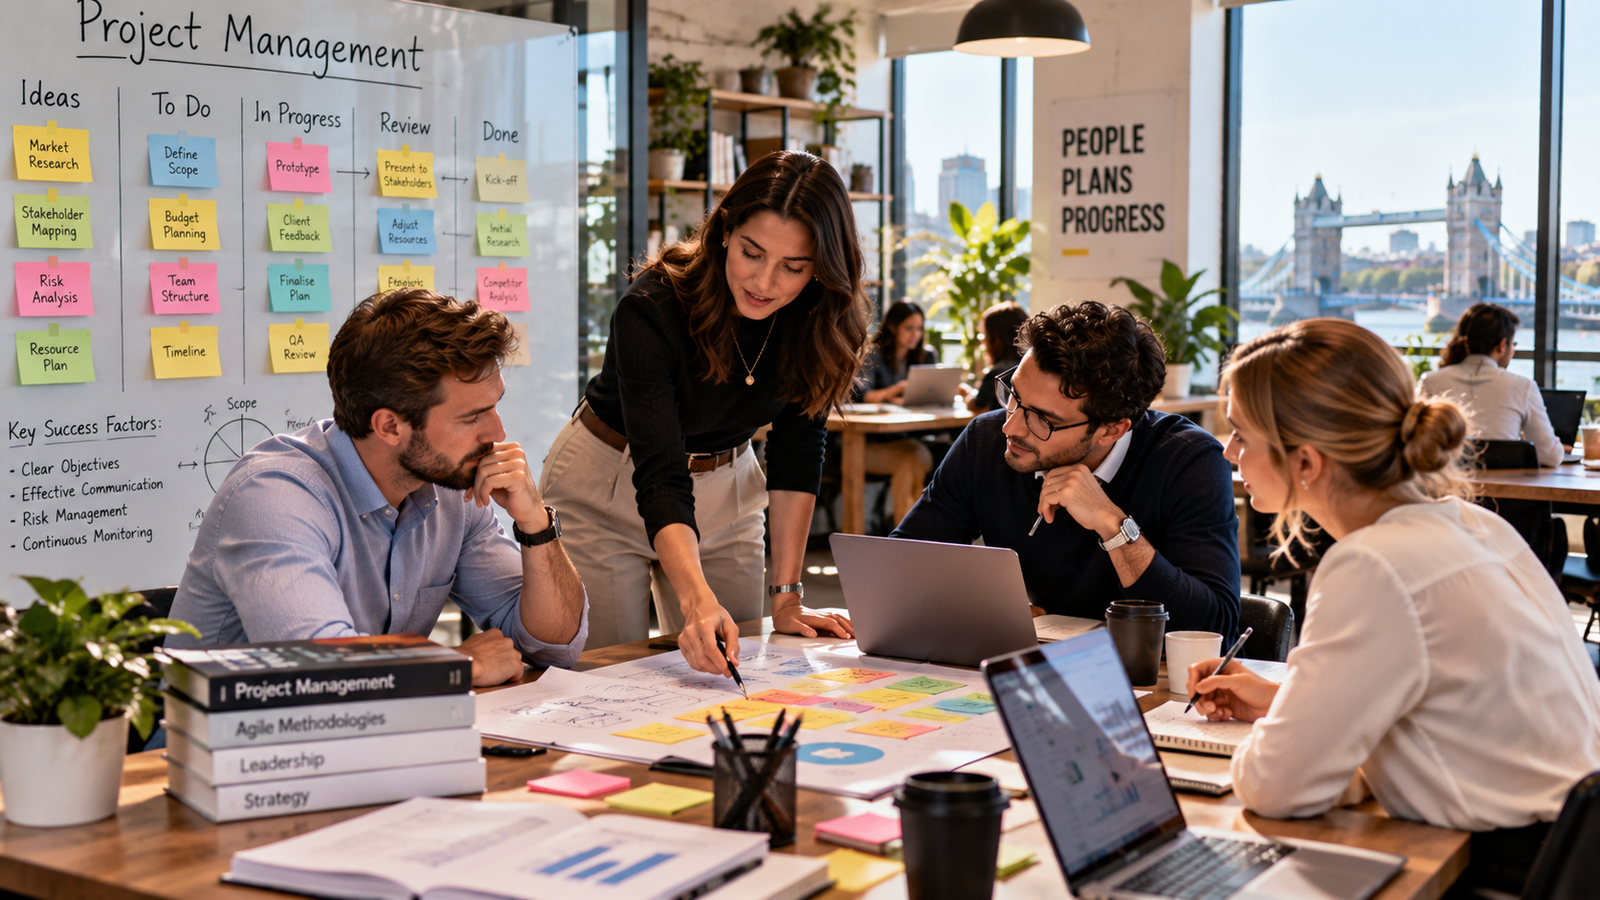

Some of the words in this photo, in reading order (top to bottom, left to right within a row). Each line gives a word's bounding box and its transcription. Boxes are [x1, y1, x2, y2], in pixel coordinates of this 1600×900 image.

[77, 0, 201, 65] Project
[225, 14, 424, 78] Management
[21, 79, 81, 108] Ideas
[152, 92, 175, 115] To
[186, 95, 211, 118] Do
[255, 101, 271, 123] In
[279, 101, 342, 133] Progress
[380, 112, 431, 135] Review
[483, 121, 519, 143] Done
[29, 139, 69, 153] Market
[1062, 123, 1145, 158] PEOPLE
[164, 146, 198, 160] Define
[29, 156, 79, 170] Research
[168, 163, 199, 178] Scope
[276, 159, 320, 178] Prototype
[385, 160, 416, 173] Present
[419, 163, 428, 174] to
[485, 173, 518, 186] Kick-off
[1062, 165, 1133, 197] PLANS
[22, 206, 84, 221] Stakeholder
[165, 211, 199, 227] Budget
[283, 214, 311, 226] Client
[1062, 203, 1165, 234] PROGRESS
[392, 218, 419, 231] Adjust
[490, 223, 512, 234] Initial
[31, 224, 77, 242] Mapping
[164, 226, 206, 243] Planning
[279, 228, 320, 241] Feedback
[388, 233, 428, 245] Resources
[487, 236, 520, 247] Research
[40, 274, 64, 287] Risk
[168, 274, 196, 286] Team
[280, 274, 315, 286] Finalise
[32, 291, 78, 308] Analysis
[162, 289, 209, 302] Structure
[289, 289, 310, 301] Plan
[288, 334, 305, 346] QA
[30, 342, 79, 356] Resource
[163, 345, 206, 357] Timeline
[284, 349, 316, 360] Review
[43, 358, 68, 372] Plan
[227, 397, 257, 412] Scope
[9, 421, 36, 446] Key
[44, 420, 98, 438] Success
[106, 415, 162, 433] Factors:
[21, 461, 54, 477] Clear
[61, 456, 120, 477] Objectives
[22, 485, 76, 501] Effective
[81, 478, 163, 497] Communication
[22, 511, 49, 526] Risk
[55, 503, 128, 525] Management
[23, 533, 88, 551] Continuous
[93, 526, 153, 543] Monitoring
[235, 681, 292, 702] Project
[296, 673, 395, 699] Management
[235, 719, 274, 740] Agile
[278, 711, 386, 733] Methodologies
[240, 752, 325, 774] Leadership
[244, 788, 311, 810] Strategy
